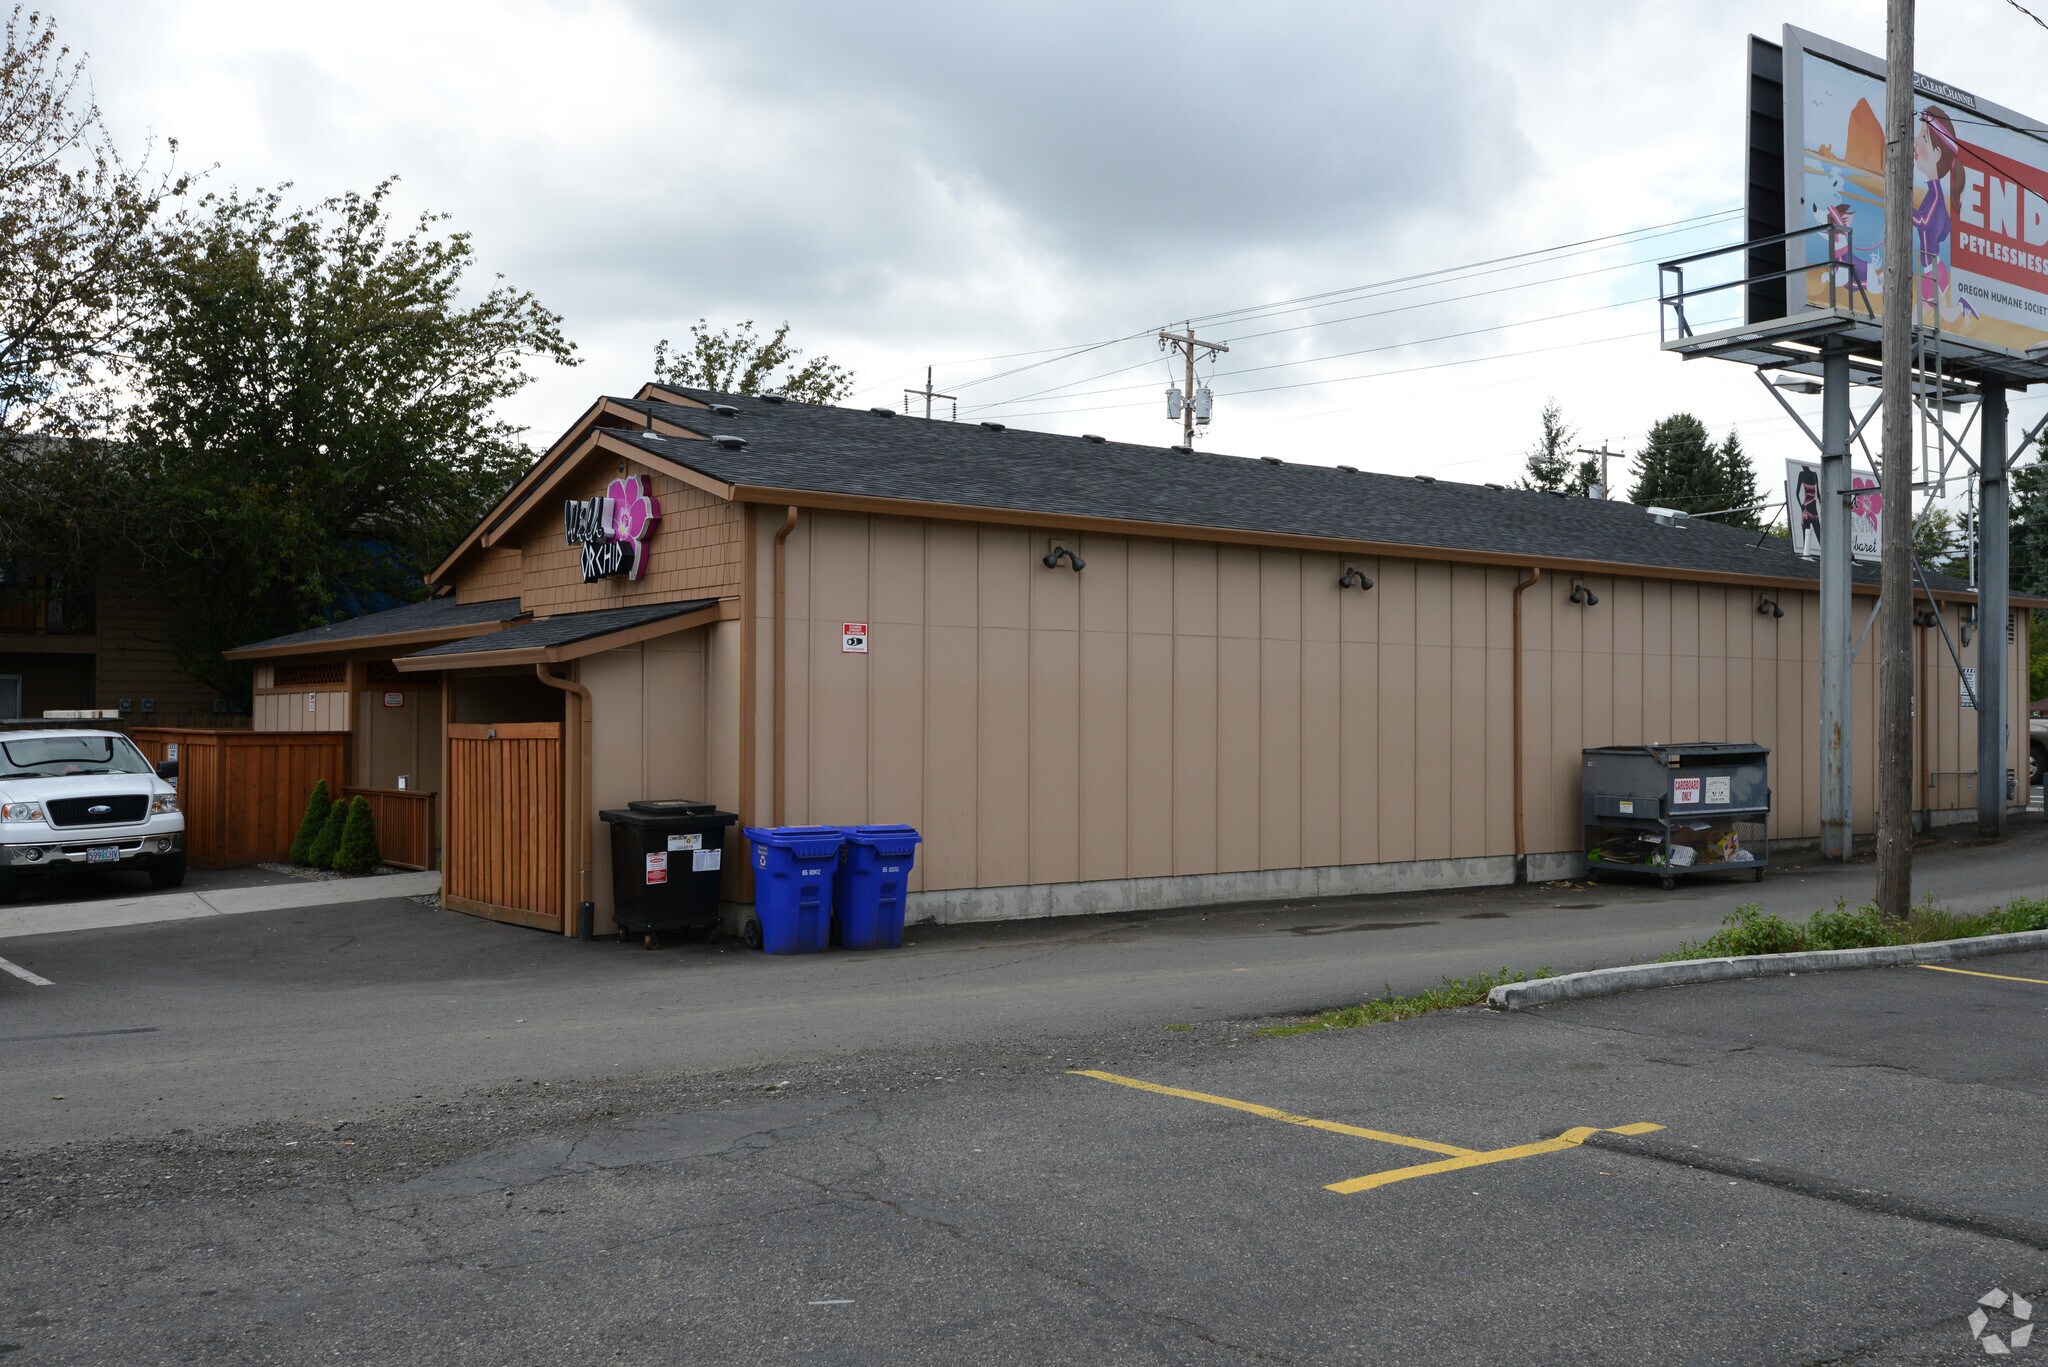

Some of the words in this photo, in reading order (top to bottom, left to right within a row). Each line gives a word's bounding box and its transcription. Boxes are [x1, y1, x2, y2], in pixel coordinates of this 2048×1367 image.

[1959, 165, 2048, 247] END
[1959, 231, 2048, 276] PETLESSNESS
[1958, 282, 1989, 300] OREGON
[1990, 291, 2023, 310] HUMANE
[2024, 301, 2048, 316] SOCIET
[1854, 535, 1877, 553] baret
[580, 541, 623, 582] ORCHID
[1674, 780, 1699, 791] CARDBOARD
[1681, 791, 1692, 801] ONLY
